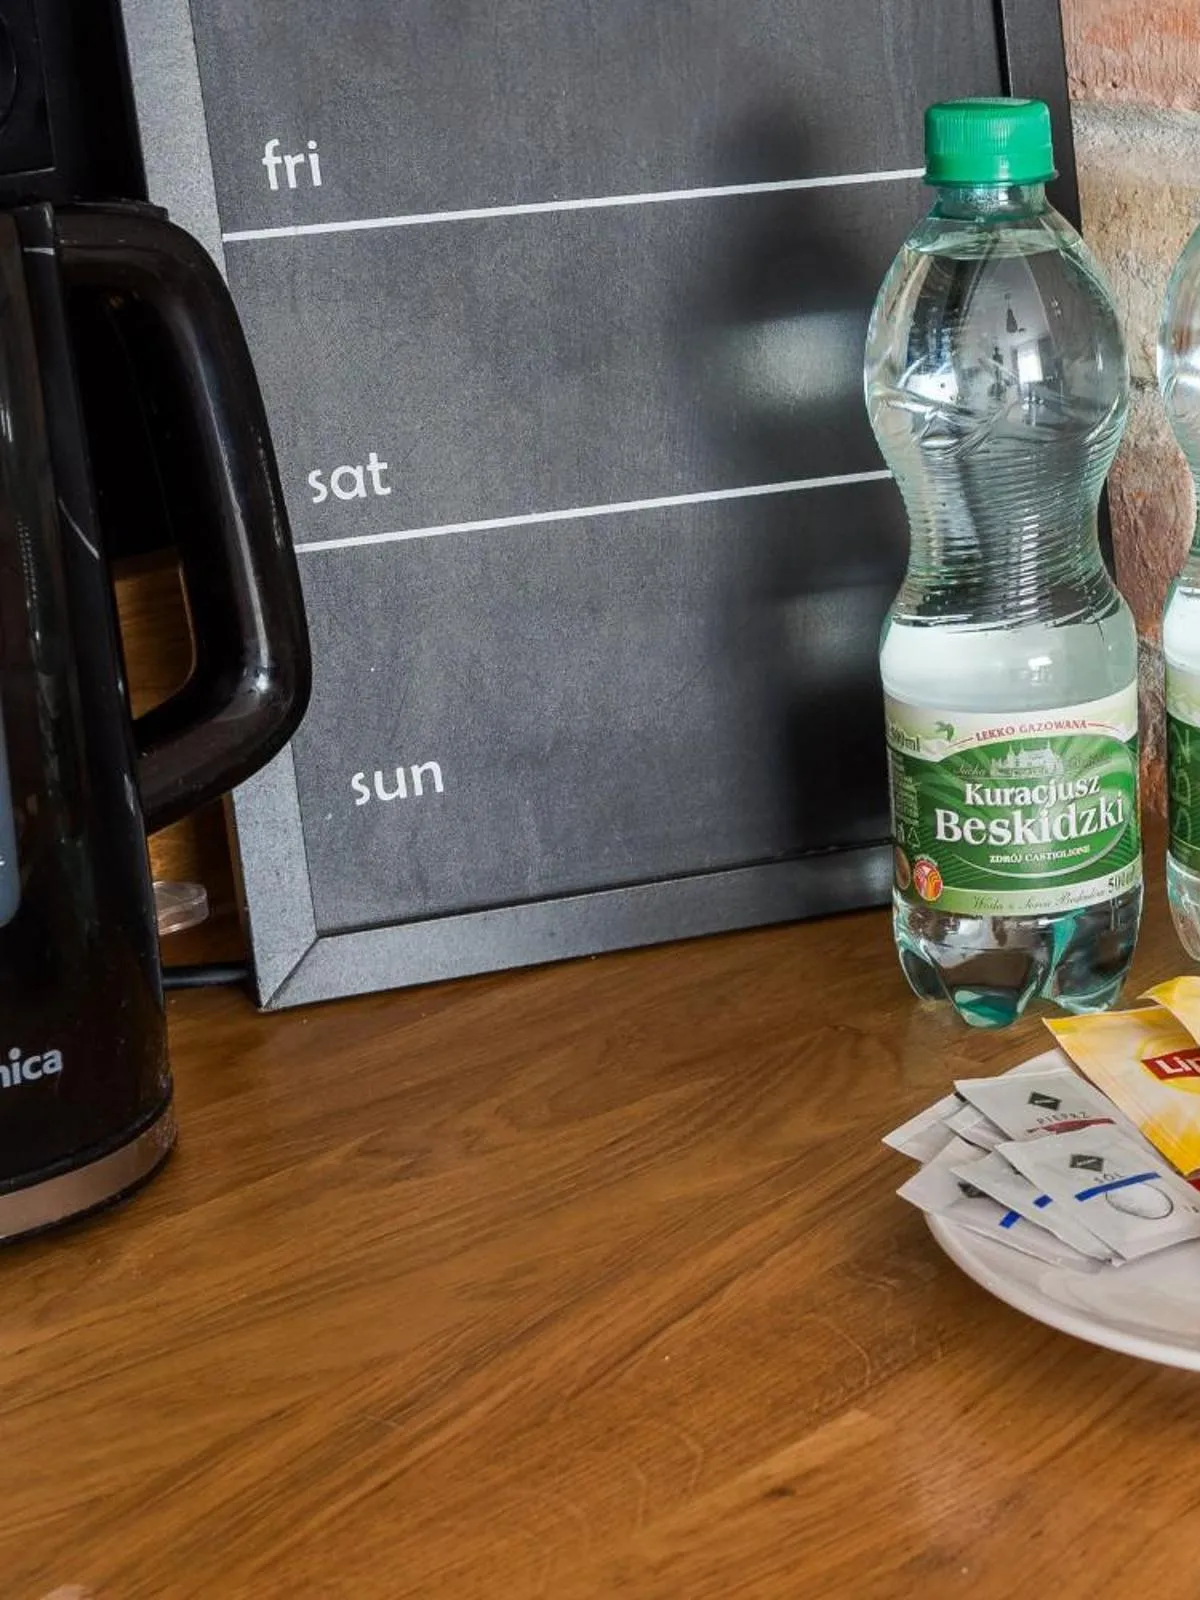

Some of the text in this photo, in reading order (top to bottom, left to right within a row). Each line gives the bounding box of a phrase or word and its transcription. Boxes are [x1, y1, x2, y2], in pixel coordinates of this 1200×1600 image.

[262, 139, 323, 190] fri
[308, 452, 392, 502] sat
[976, 719, 1088, 741] LEKKO GAZOWANA
[351, 760, 444, 806] sun
[965, 775, 1100, 807] Kuracjusz
[935, 791, 1125, 846] Beskidzki
